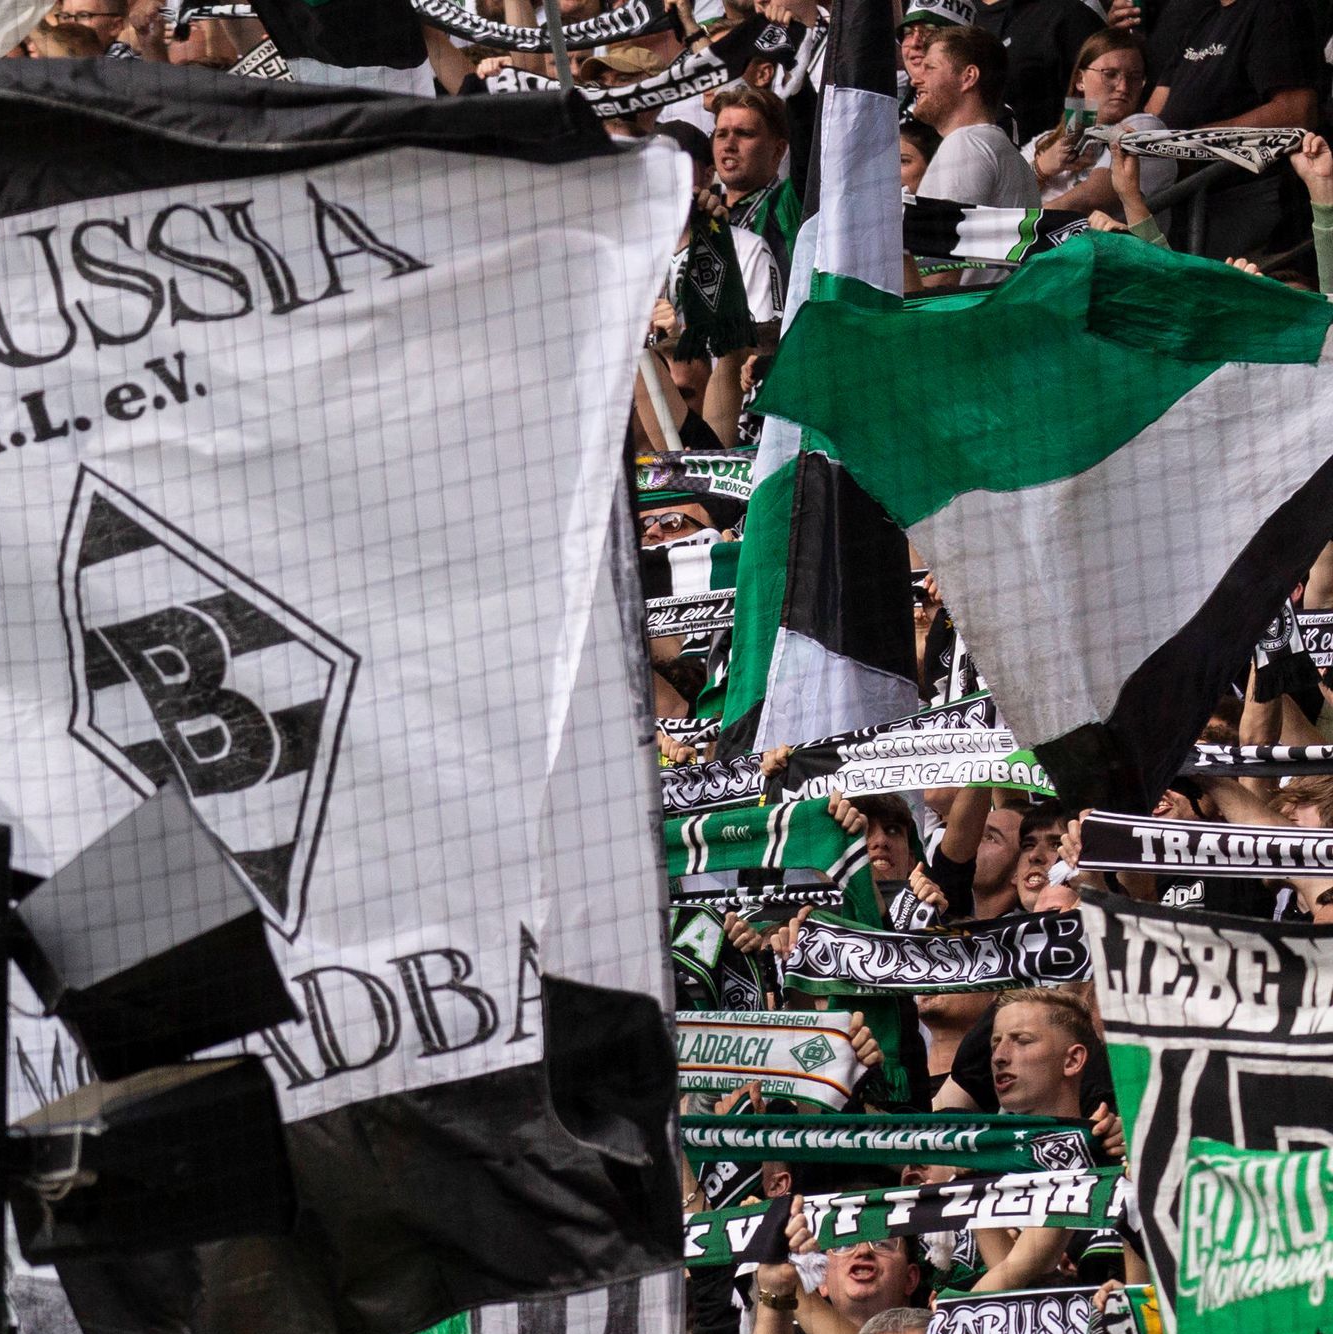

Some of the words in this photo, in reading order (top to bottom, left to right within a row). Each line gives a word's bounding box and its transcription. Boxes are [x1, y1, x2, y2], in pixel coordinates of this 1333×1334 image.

[592, 69, 729, 118] GLADBACH
[102, 353, 208, 417] e.V.
[713, 478, 753, 498] MÖNC
[647, 607, 678, 627] eiß
[837, 732, 1013, 763] NORDKURVE
[678, 1036, 772, 1068] LADBACH
